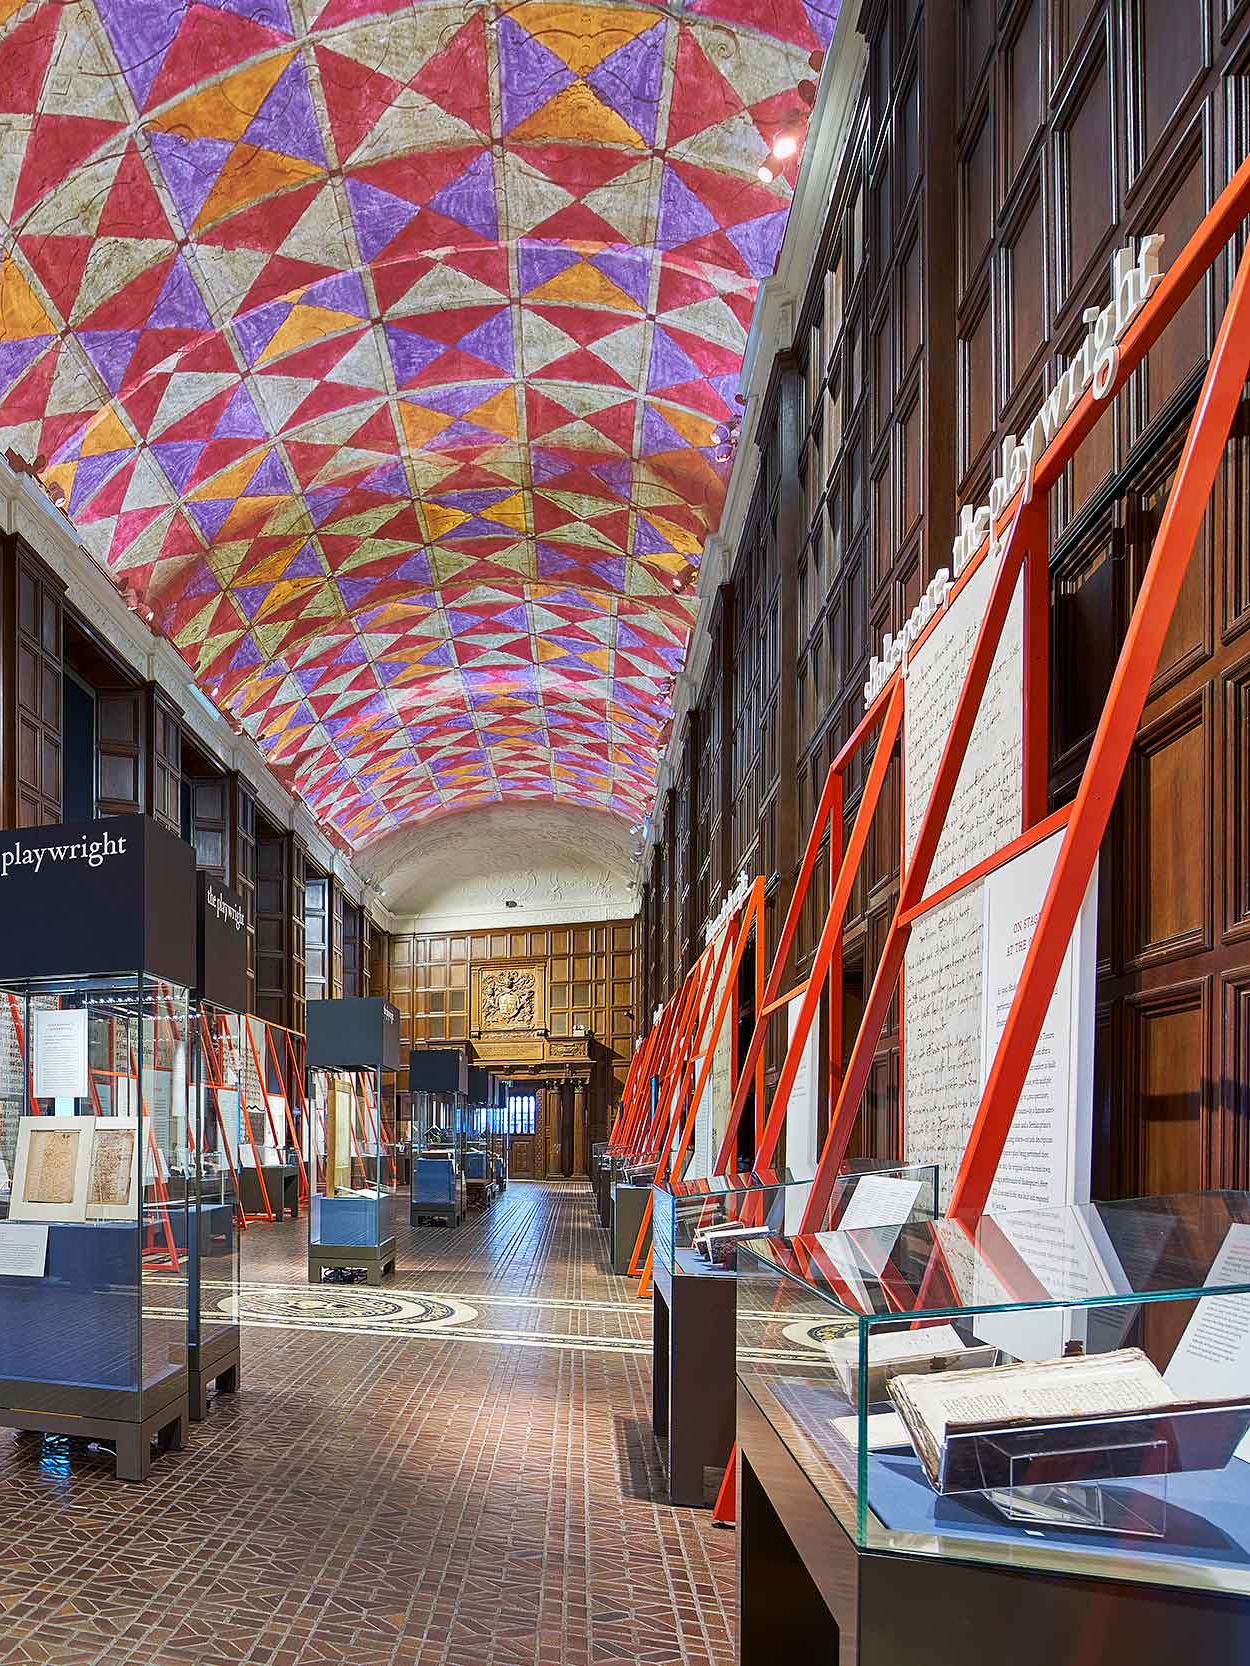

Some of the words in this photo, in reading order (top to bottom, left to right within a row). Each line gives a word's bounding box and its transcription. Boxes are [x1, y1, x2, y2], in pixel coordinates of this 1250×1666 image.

[1, 831, 126, 876] playwright
[208, 885, 216, 907] the
[217, 892, 244, 930] playwright
